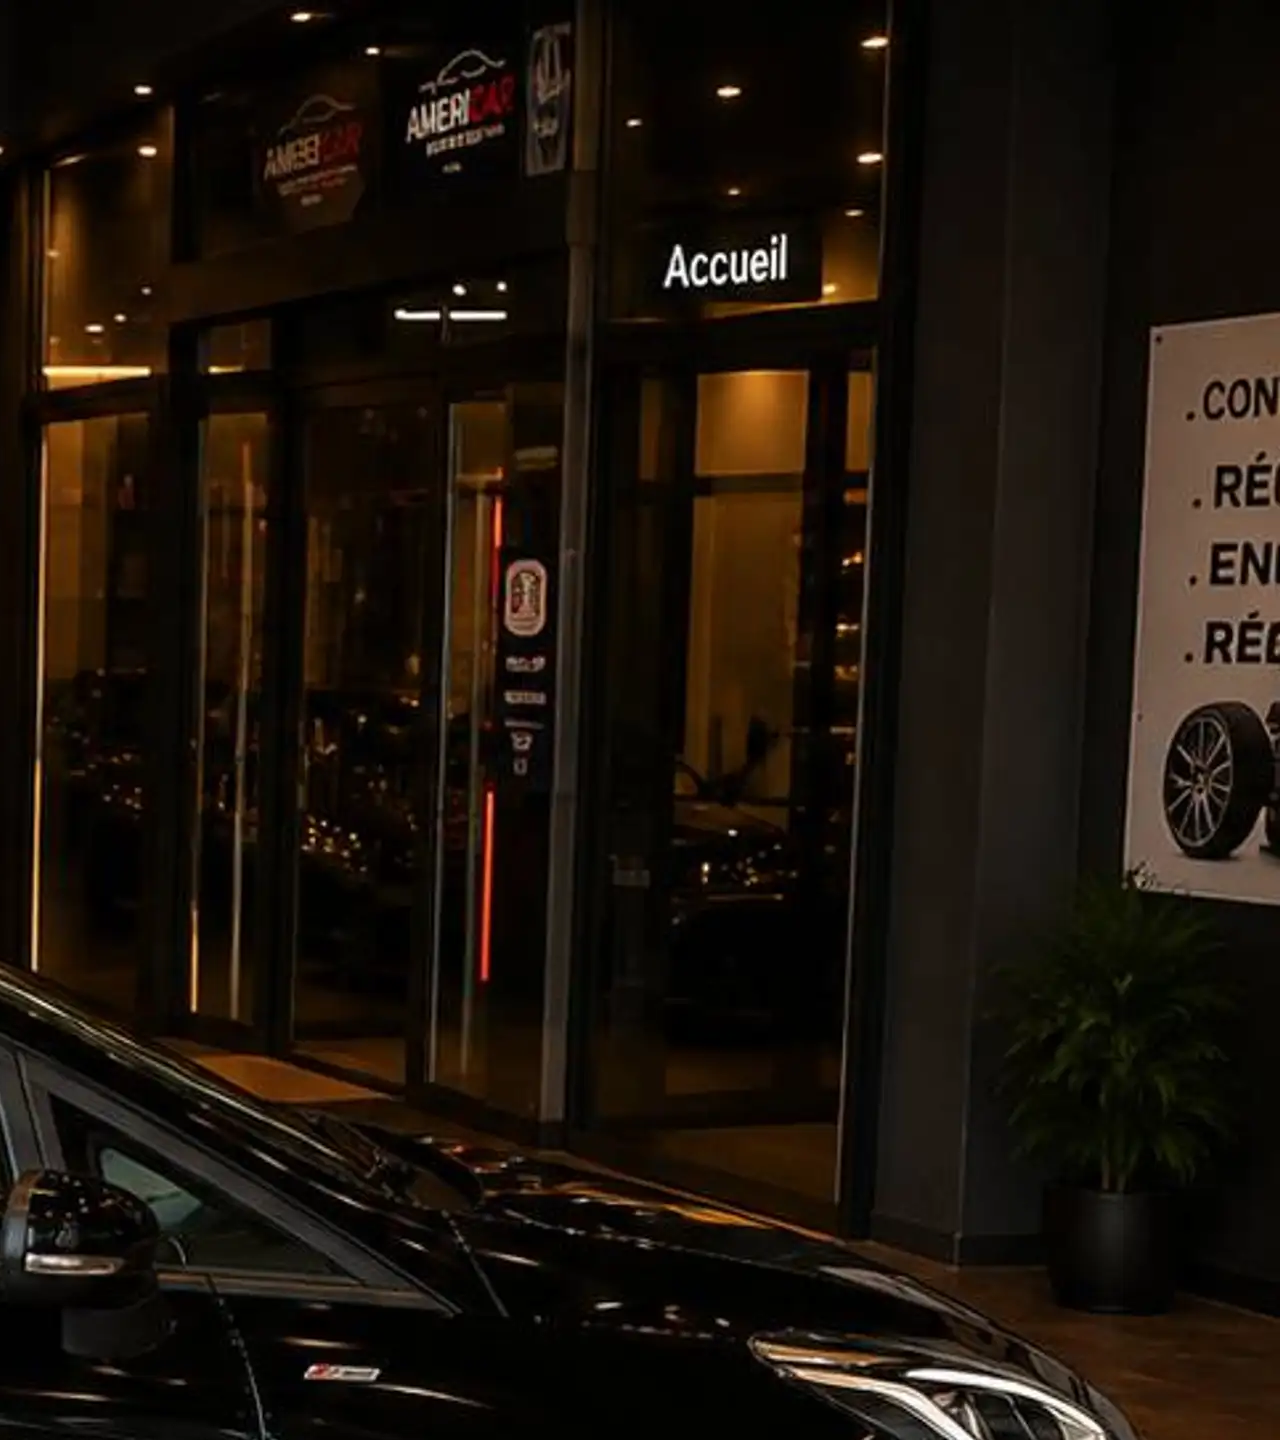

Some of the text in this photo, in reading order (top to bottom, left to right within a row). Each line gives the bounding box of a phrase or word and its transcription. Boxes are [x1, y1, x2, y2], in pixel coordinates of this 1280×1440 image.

[663, 233, 788, 288] Accueil
[1203, 377, 1280, 420] CON
[1214, 450, 1280, 508] RÉ
[1209, 541, 1280, 586] EN
